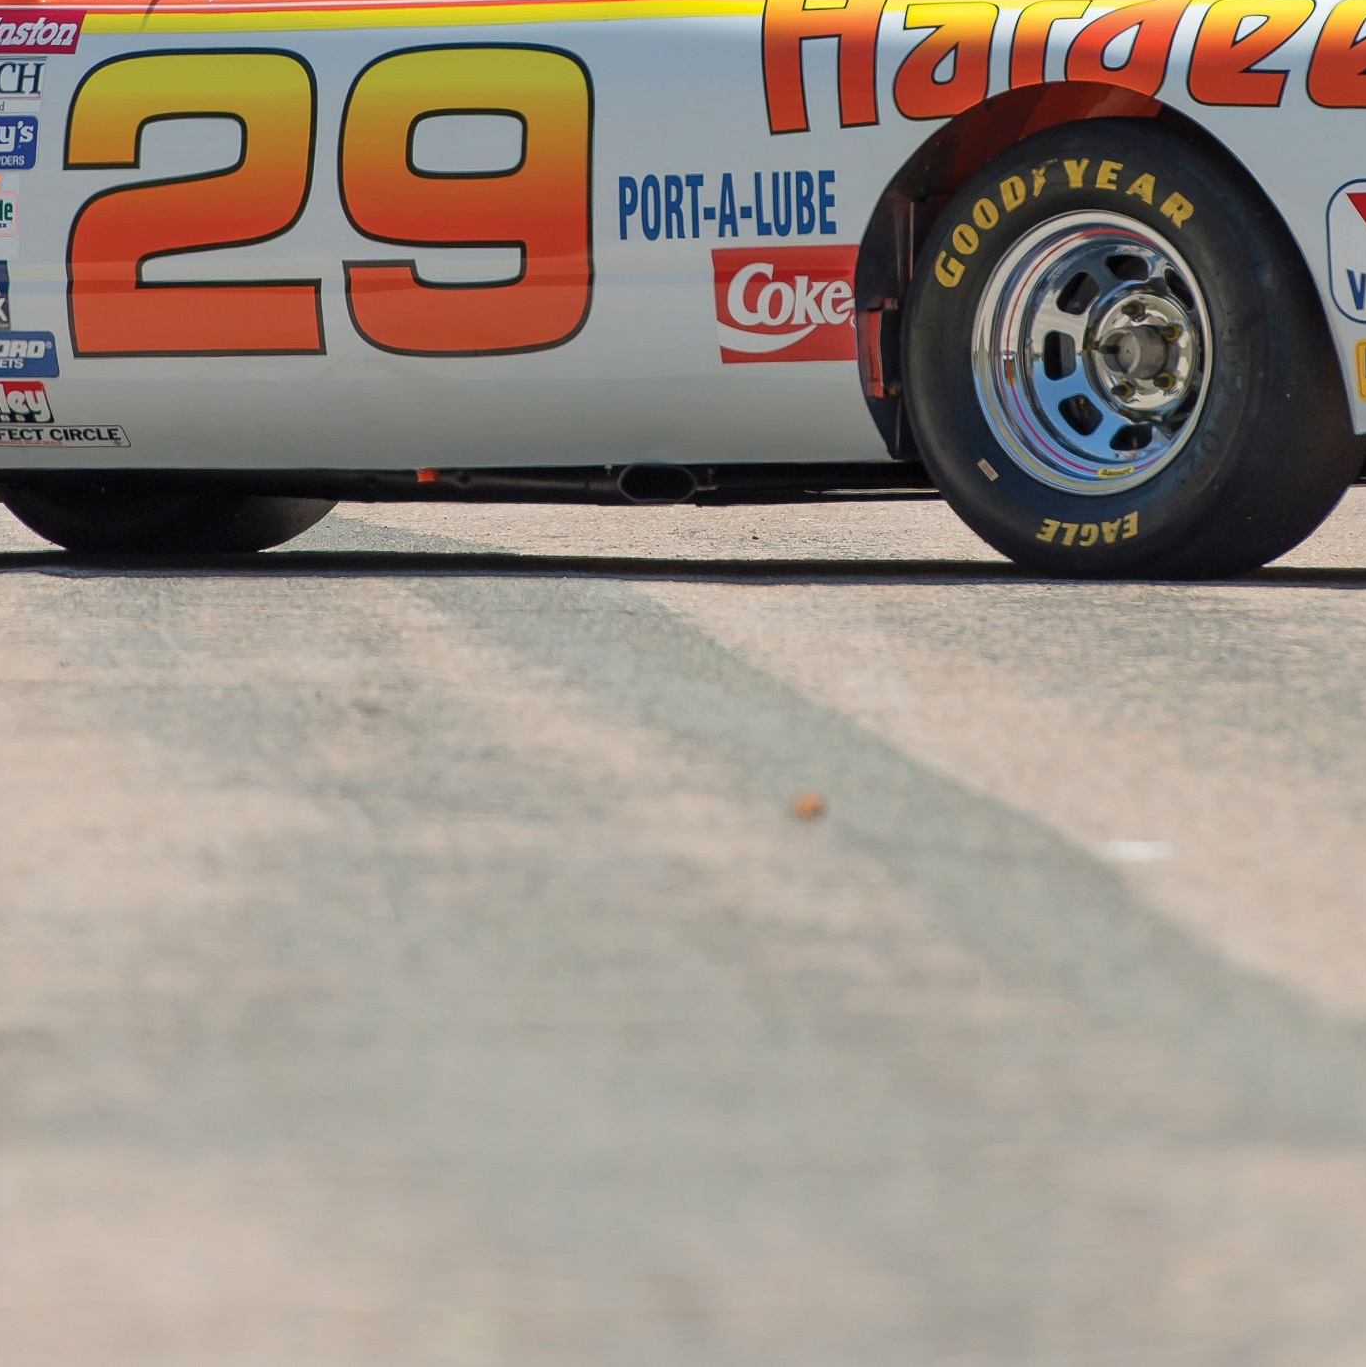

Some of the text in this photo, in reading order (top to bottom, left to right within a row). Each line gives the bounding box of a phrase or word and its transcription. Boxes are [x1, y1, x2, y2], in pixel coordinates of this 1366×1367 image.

[63, 42, 596, 359] 29
[619, 170, 837, 241] PORT-A-LUBE
[727, 262, 855, 327] Coke
[49, 428, 122, 441] CIRCLE
[1035, 510, 1139, 547] EAGLE
